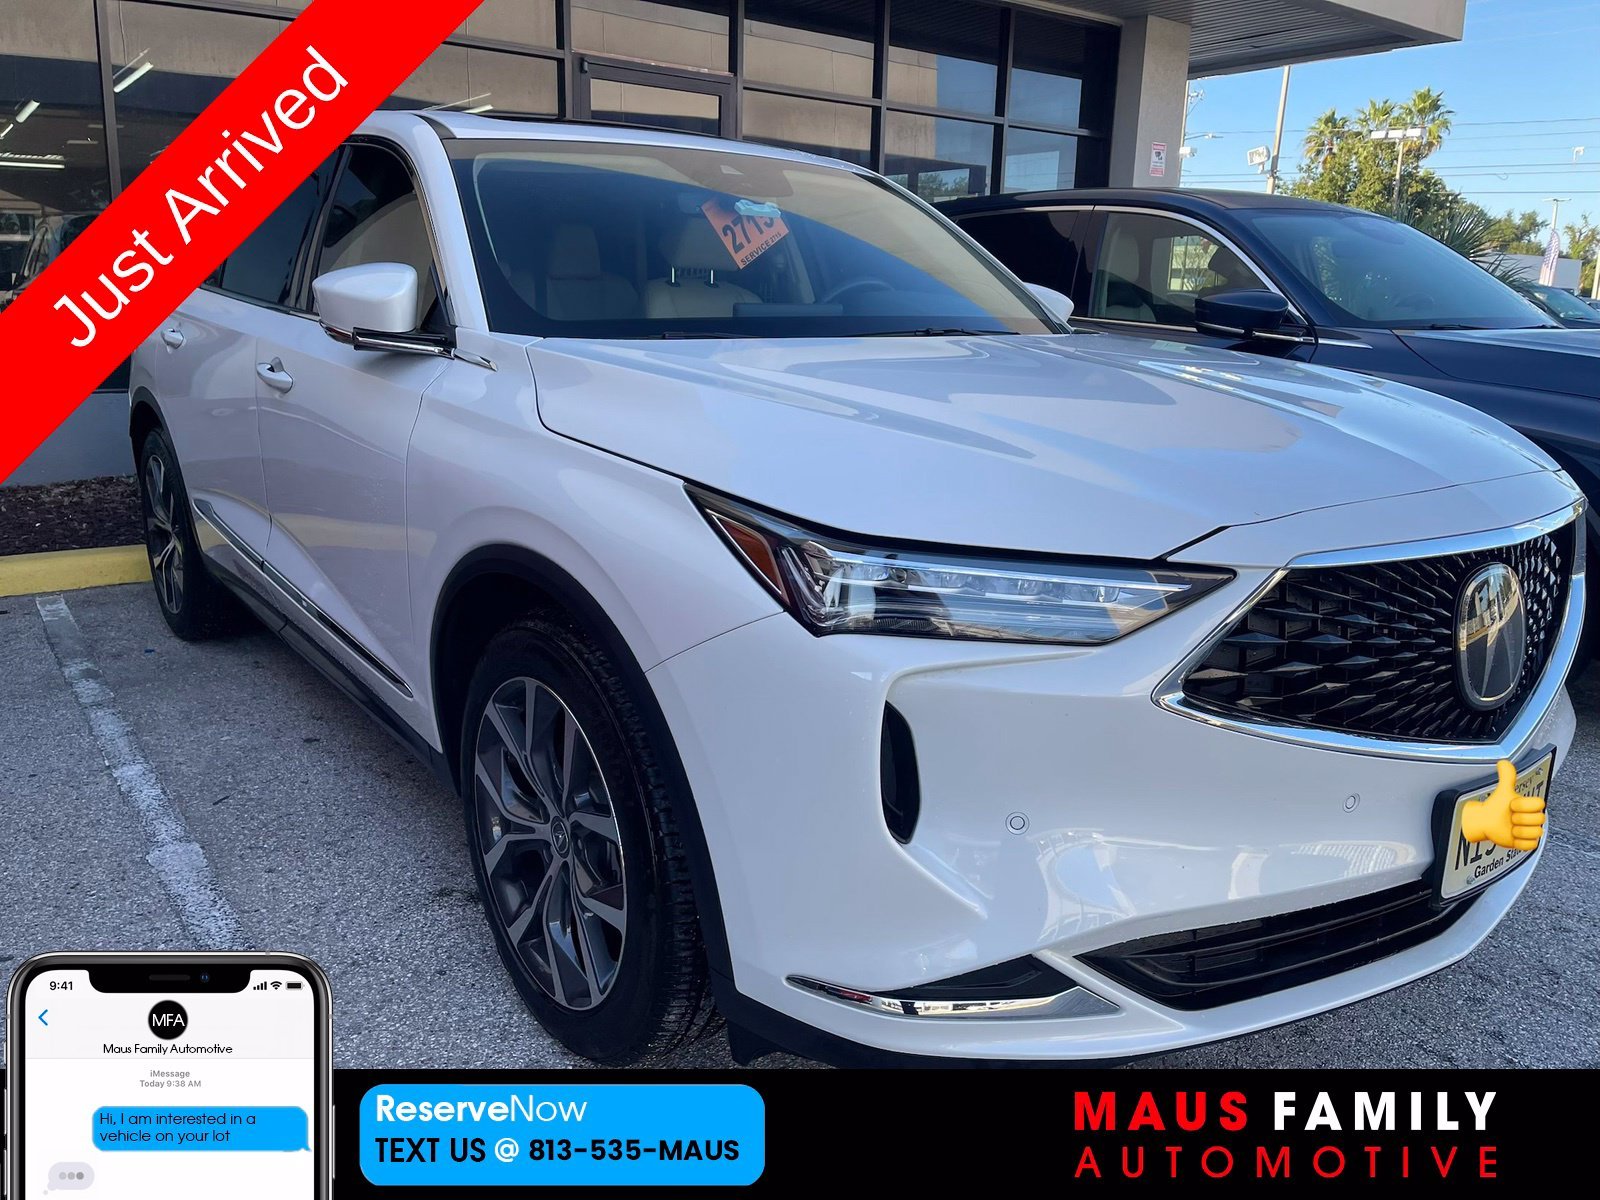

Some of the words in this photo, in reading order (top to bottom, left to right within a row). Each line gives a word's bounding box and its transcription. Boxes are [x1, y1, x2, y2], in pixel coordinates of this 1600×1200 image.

[740, 241, 770, 266] SERVICE
[1474, 857, 1504, 879] Garden
[1505, 848, 1528, 863] Sta
